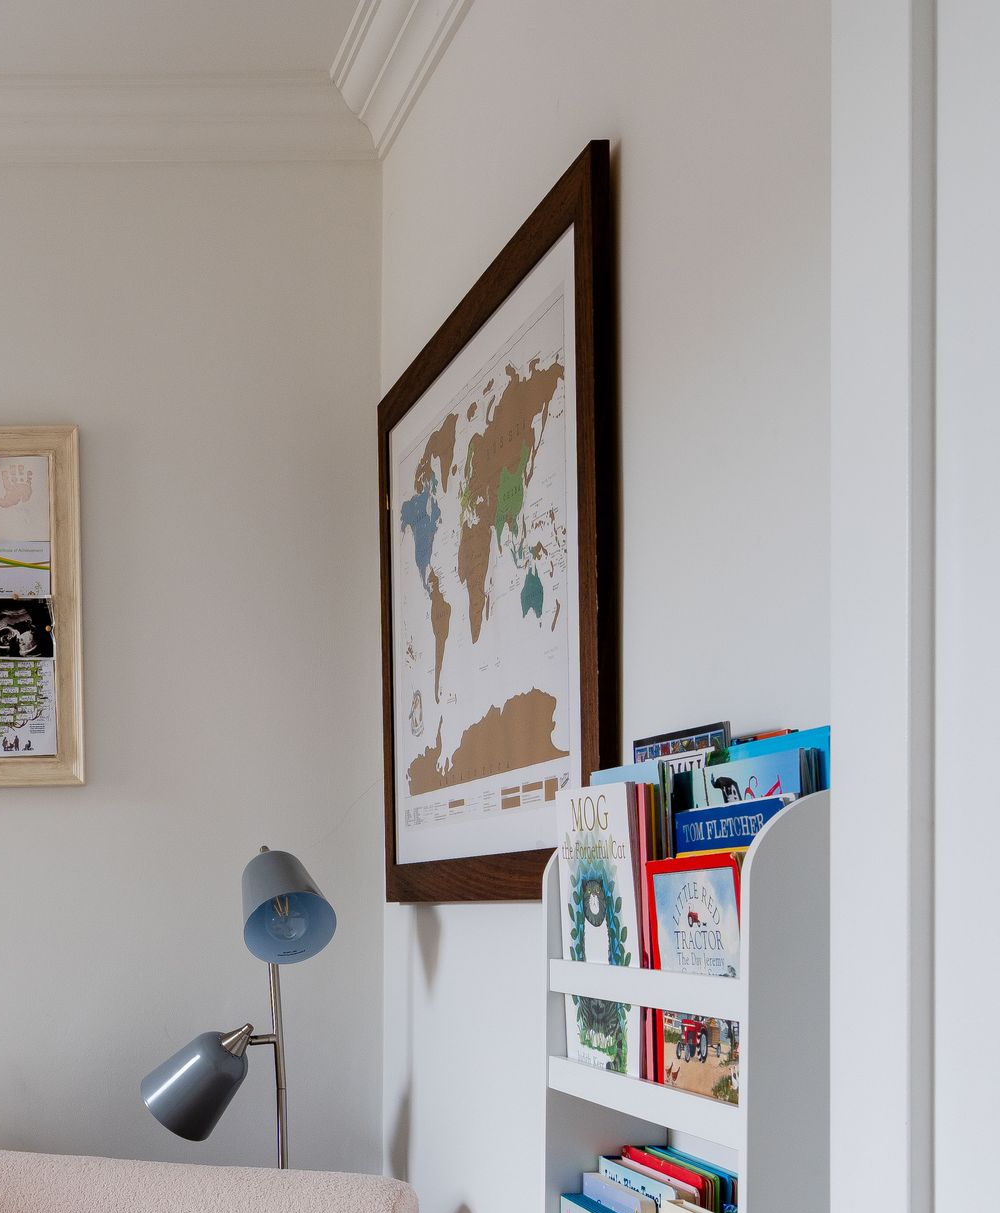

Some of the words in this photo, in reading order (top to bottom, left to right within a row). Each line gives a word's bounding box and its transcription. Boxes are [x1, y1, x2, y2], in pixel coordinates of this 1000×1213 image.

[570, 795, 609, 832] MOG
[682, 823, 703, 843] TOM
[705, 813, 764, 839] FLETCHER
[562, 841, 574, 860] the
[575, 839, 610, 864] Forgetful
[612, 841, 627, 860] Cat
[673, 882, 699, 926] LITTLE
[701, 887, 721, 925] RED
[674, 930, 724, 951] TRACTOR
[677, 952, 690, 966] The
[691, 952, 702, 967] Day
